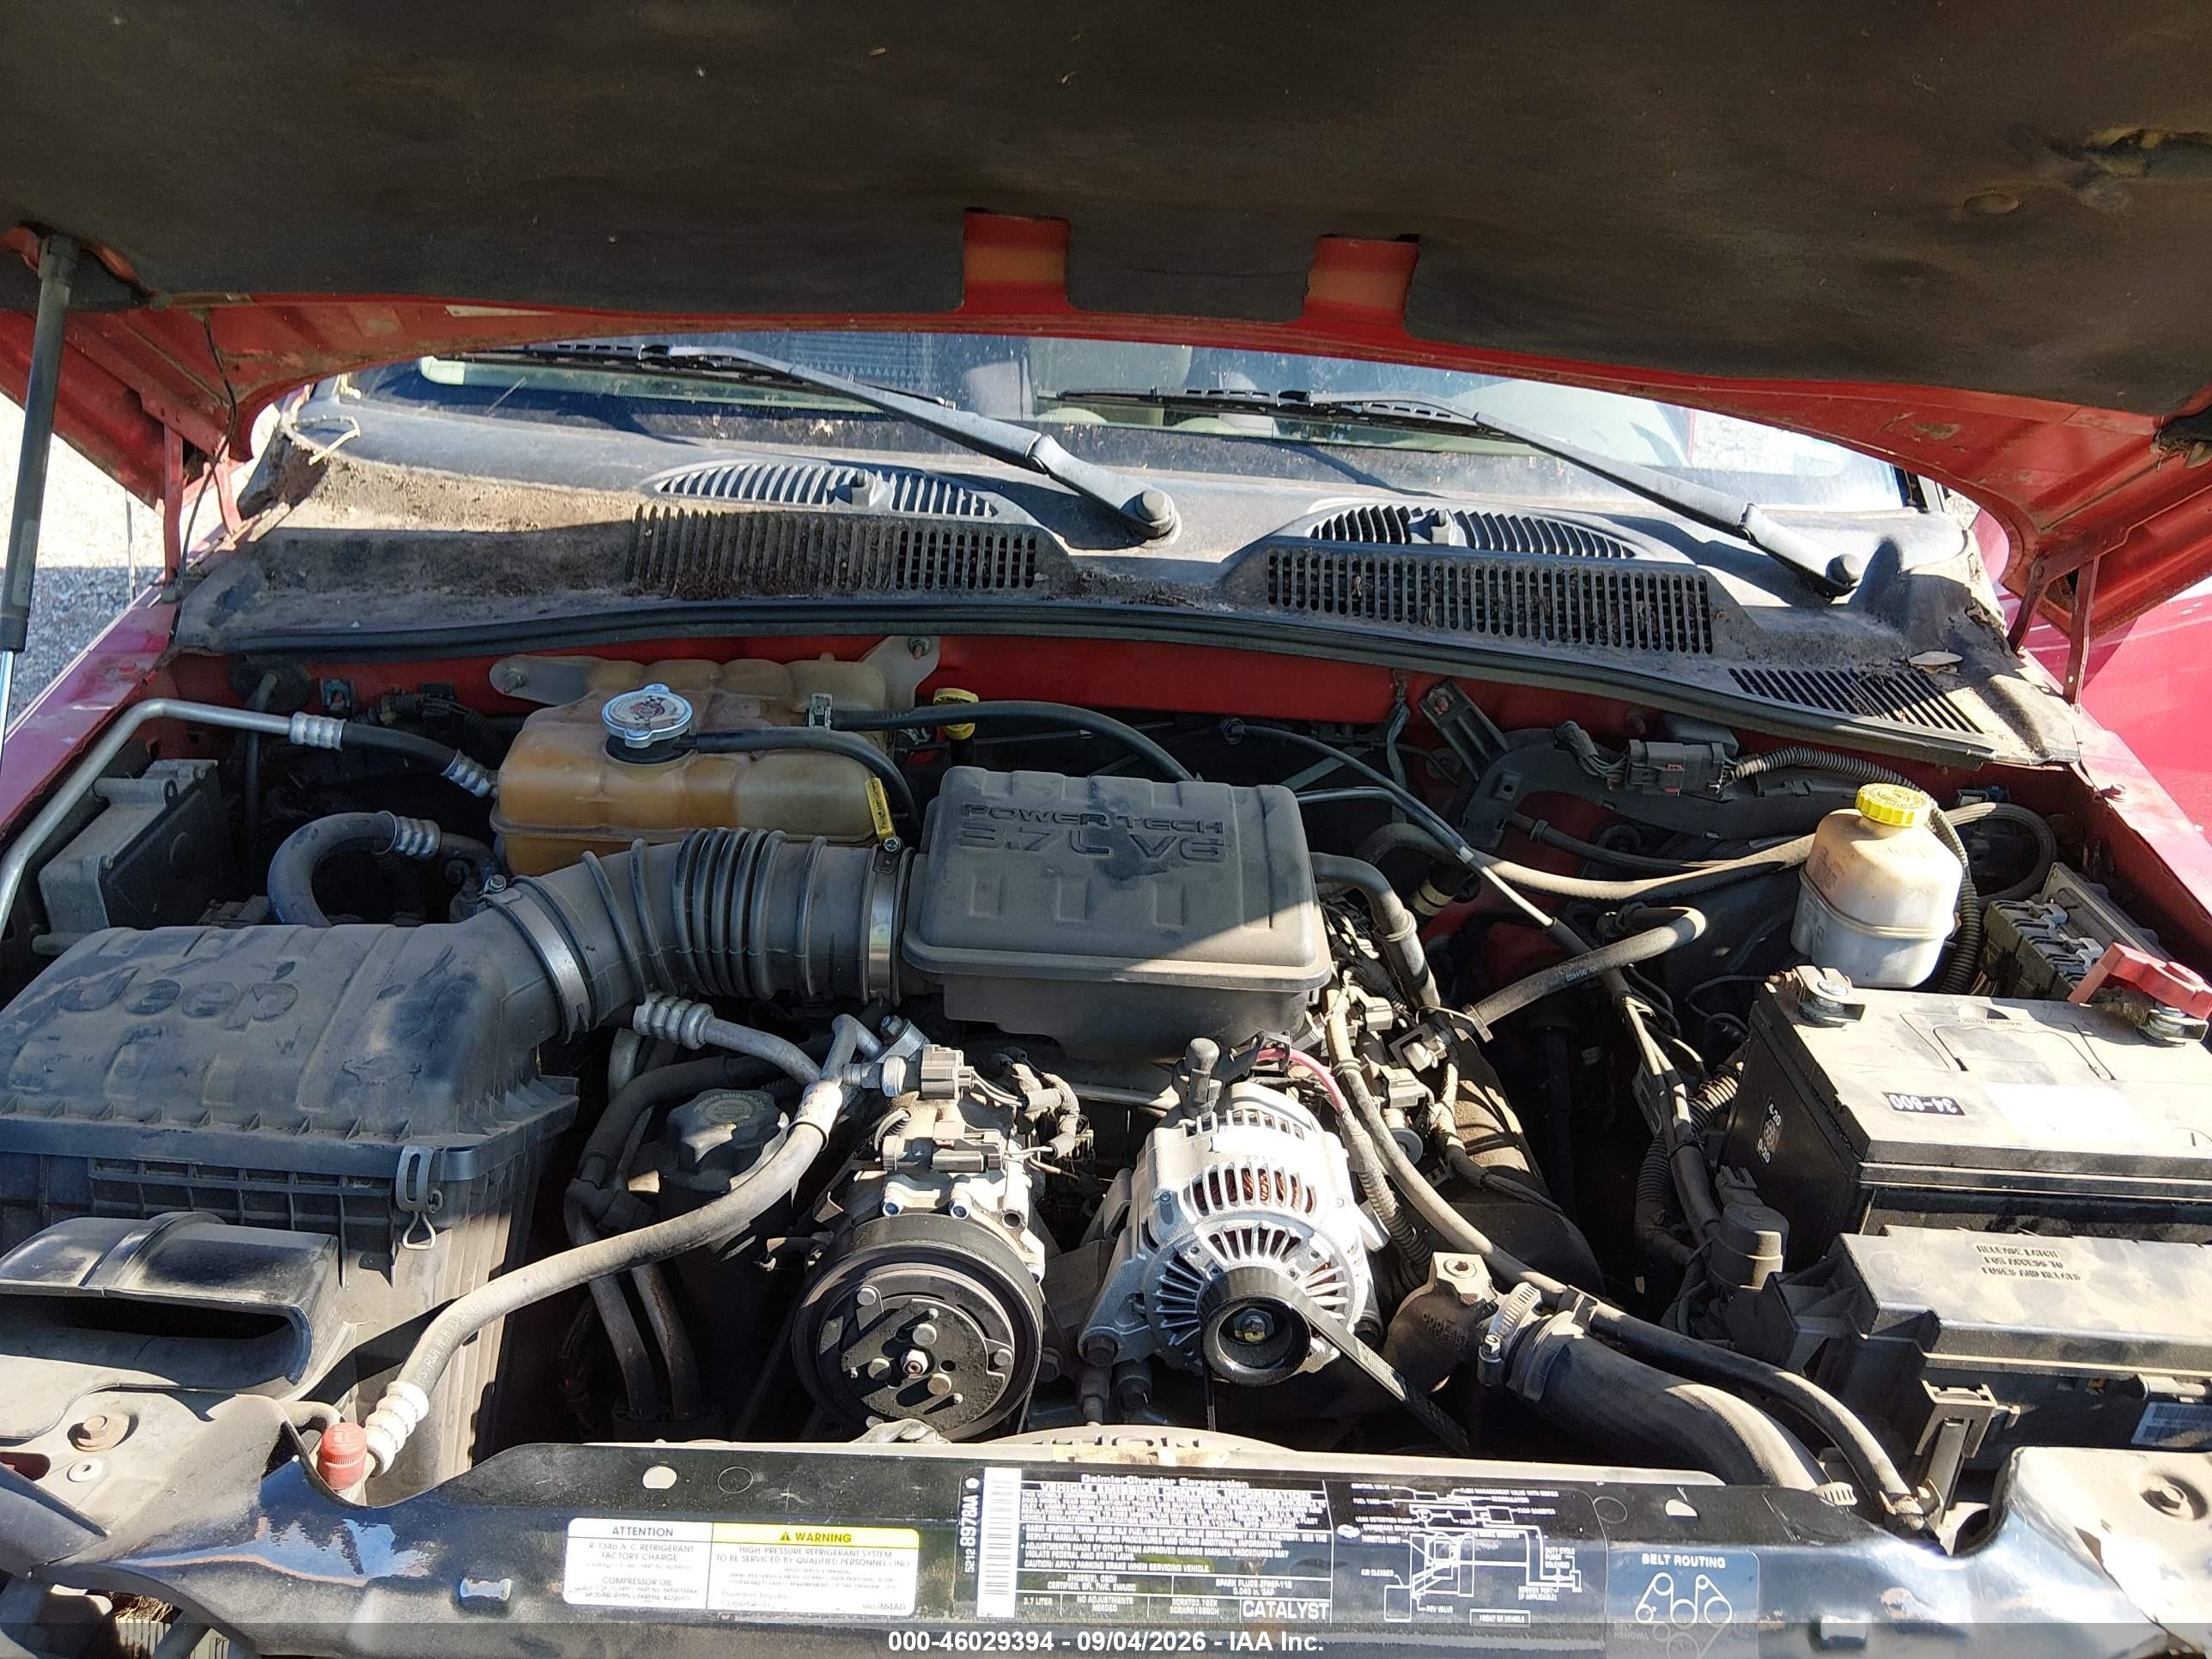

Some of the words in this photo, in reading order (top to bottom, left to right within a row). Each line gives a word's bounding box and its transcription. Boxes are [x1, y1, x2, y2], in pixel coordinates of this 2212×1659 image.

[1129, 832, 1227, 863] V6
[58, 967, 299, 1031] Jeep
[1888, 1094, 1957, 1114] 34-600
[1976, 1244, 2023, 1255] RELEASE
[2024, 1249, 2059, 1259] LATCH
[1984, 1256, 2007, 1266] FOR
[2008, 1258, 2048, 1267] ACCESS
[2048, 1261, 2063, 1269] TO
[1981, 1267, 2016, 1276] FUSES
[2020, 1269, 2039, 1278] AND
[2041, 1271, 2081, 1280] RELAYS
[1179, 1477, 1249, 1490] Corporation
[1040, 1483, 1092, 1493] VEHICLE
[1097, 1485, 1158, 1496] EMISSION
[1163, 1487, 1219, 1498] CONTROL
[1224, 1490, 1312, 1501] INFORMATION
[611, 1526, 673, 1537] ATTENTION
[795, 1532, 853, 1543] WARNING
[1025, 1532, 1053, 1540] SERVICE
[1053, 1533, 1080, 1541] MANUAL
[1095, 1534, 1121, 1544] PROPER
[1121, 1535, 1164, 1545] PROCEDURES
[1164, 1536, 1178, 1546] AND
[1179, 1537, 1200, 1547] OTHER
[639, 1544, 694, 1554] REFRIGERANT
[738, 1546, 761, 1554] HIGH
[764, 1547, 802, 1556] PRESSURE
[805, 1548, 860, 1559] REFRIGERANT
[861, 1550, 893, 1559] SYSTEM
[1024, 1549, 1050, 1559] VIOLATE
[1051, 1550, 1079, 1559] FEDERAL
[1079, 1551, 1095, 1559] AND
[1095, 1552, 1115, 1560] STATE
[1025, 1541, 1072, 1551] ADJUSTMENTS
[1073, 1543, 1091, 1552] MADE
[1092, 1544, 1102, 1553] BY
[1102, 1544, 1123, 1553] OTHER
[1124, 1545, 1142, 1554] THAN
[1142, 1546, 1176, 1555] APPROVED
[1176, 1547, 1204, 1556] SERVICE
[1204, 1547, 1231, 1557] MANUAL
[1274, 1549, 1290, 1559] MAY
[601, 1552, 638, 1561] FACTORY
[641, 1553, 677, 1563] CHARGE
[741, 1555, 781, 1564] SERVICED
[796, 1557, 838, 1566] QUALIFIED
[840, 1559, 887, 1568] PERSONNEL
[1641, 1553, 1671, 1565] BELT
[1674, 1555, 1726, 1569] ROUTING
[1054, 1560, 1075, 1570] APPLY
[1076, 1561, 1105, 1571] PARKING
[1105, 1562, 1127, 1571] BRAKE
[1127, 1562, 1148, 1571] WHEN
[1148, 1563, 1182, 1572] SERVICING
[1360, 1568, 1370, 1577] AIR
[1370, 1569, 1395, 1577] CLEANER
[602, 1577, 658, 1587] COMPRESSOR
[659, 1577, 673, 1587] OIL
[1215, 1577, 1237, 1588] SPARK
[1023, 1597, 1034, 1606] 3.7
[1036, 1597, 1053, 1606] LITER
[1076, 1595, 1086, 1604] NO
[1087, 1595, 1134, 1605] ADJUSTMENTS
[1243, 1600, 1330, 1620] CATALYST
[1437, 1605, 1454, 1613] VALVE
[1479, 1614, 1496, 1623] FRONT
[1504, 1615, 1525, 1624] VEHICLE
